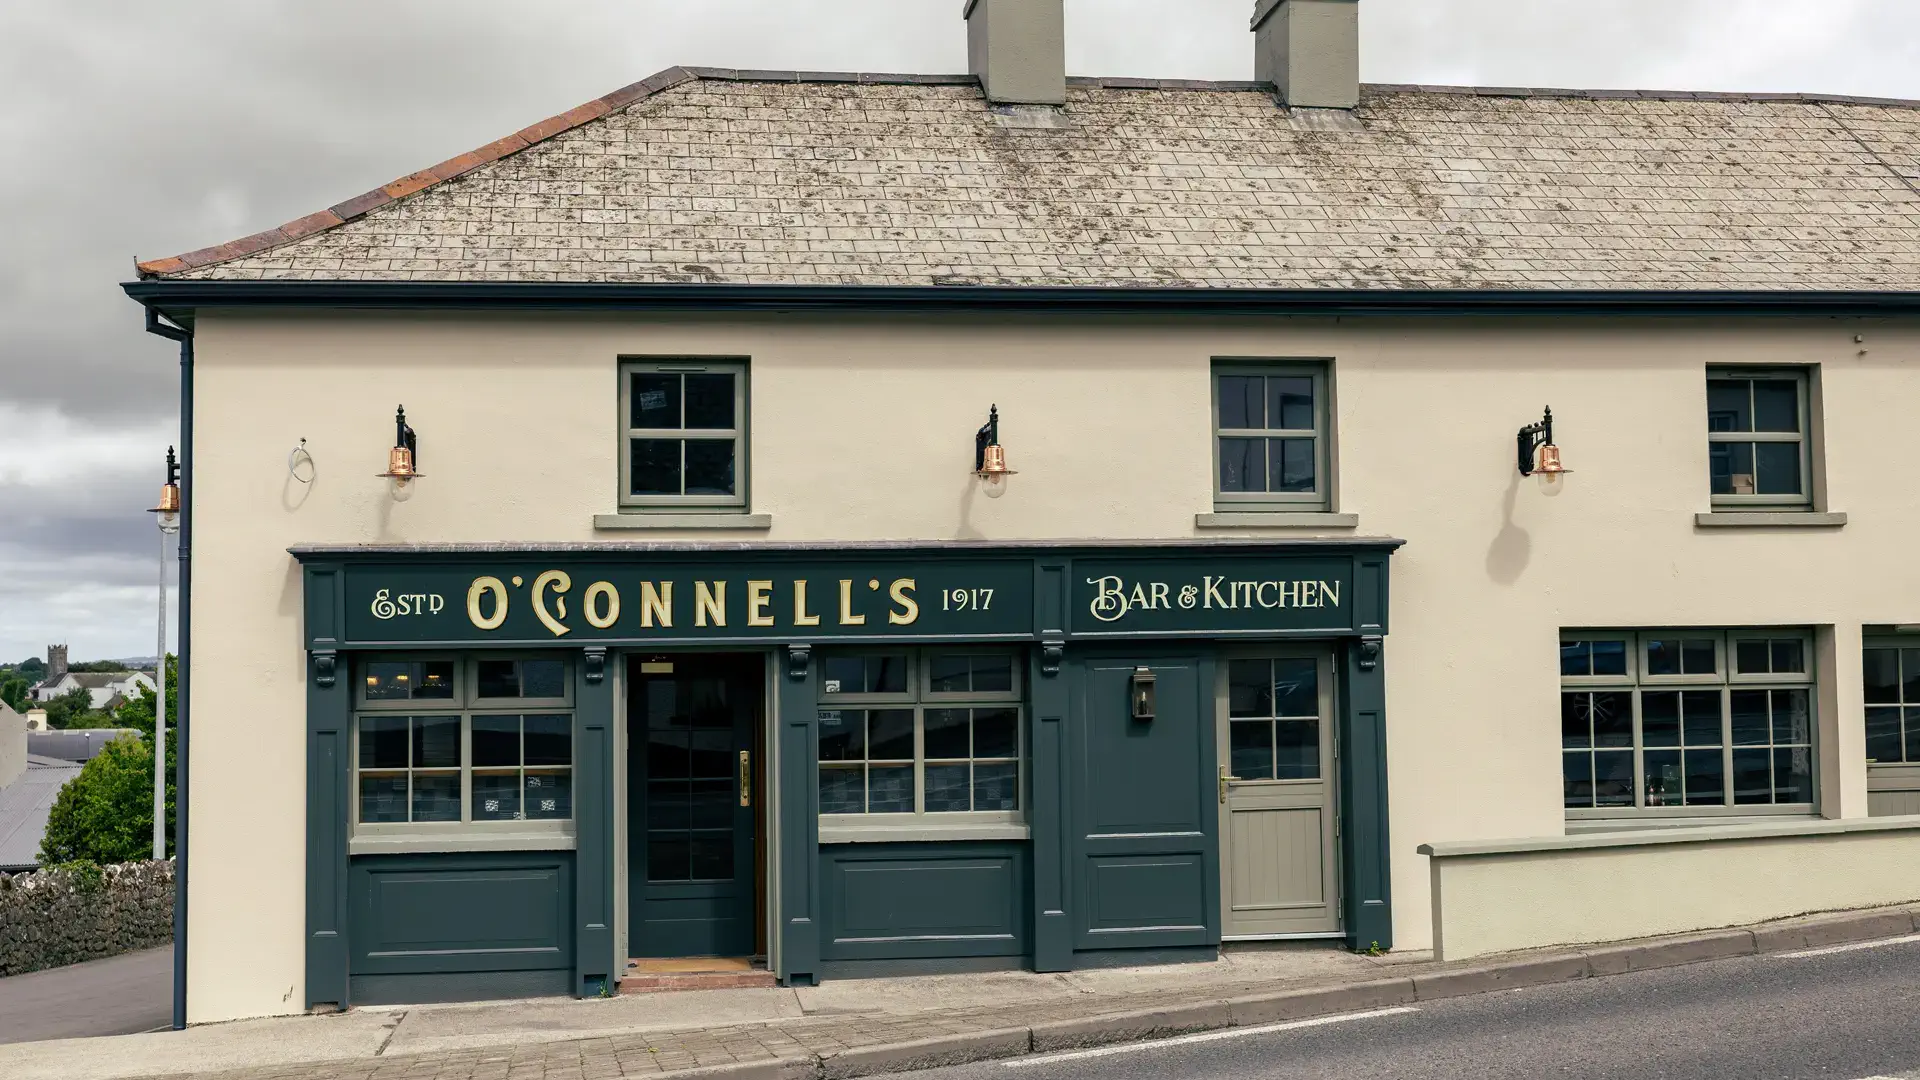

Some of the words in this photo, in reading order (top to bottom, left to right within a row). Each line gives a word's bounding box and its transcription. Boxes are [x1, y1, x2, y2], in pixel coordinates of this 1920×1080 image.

[466, 569, 919, 637] O'CONNELL'S
[942, 588, 994, 611] 1917
[1177, 585, 1199, 609] &
[1202, 575, 1341, 609] KITCHEN
